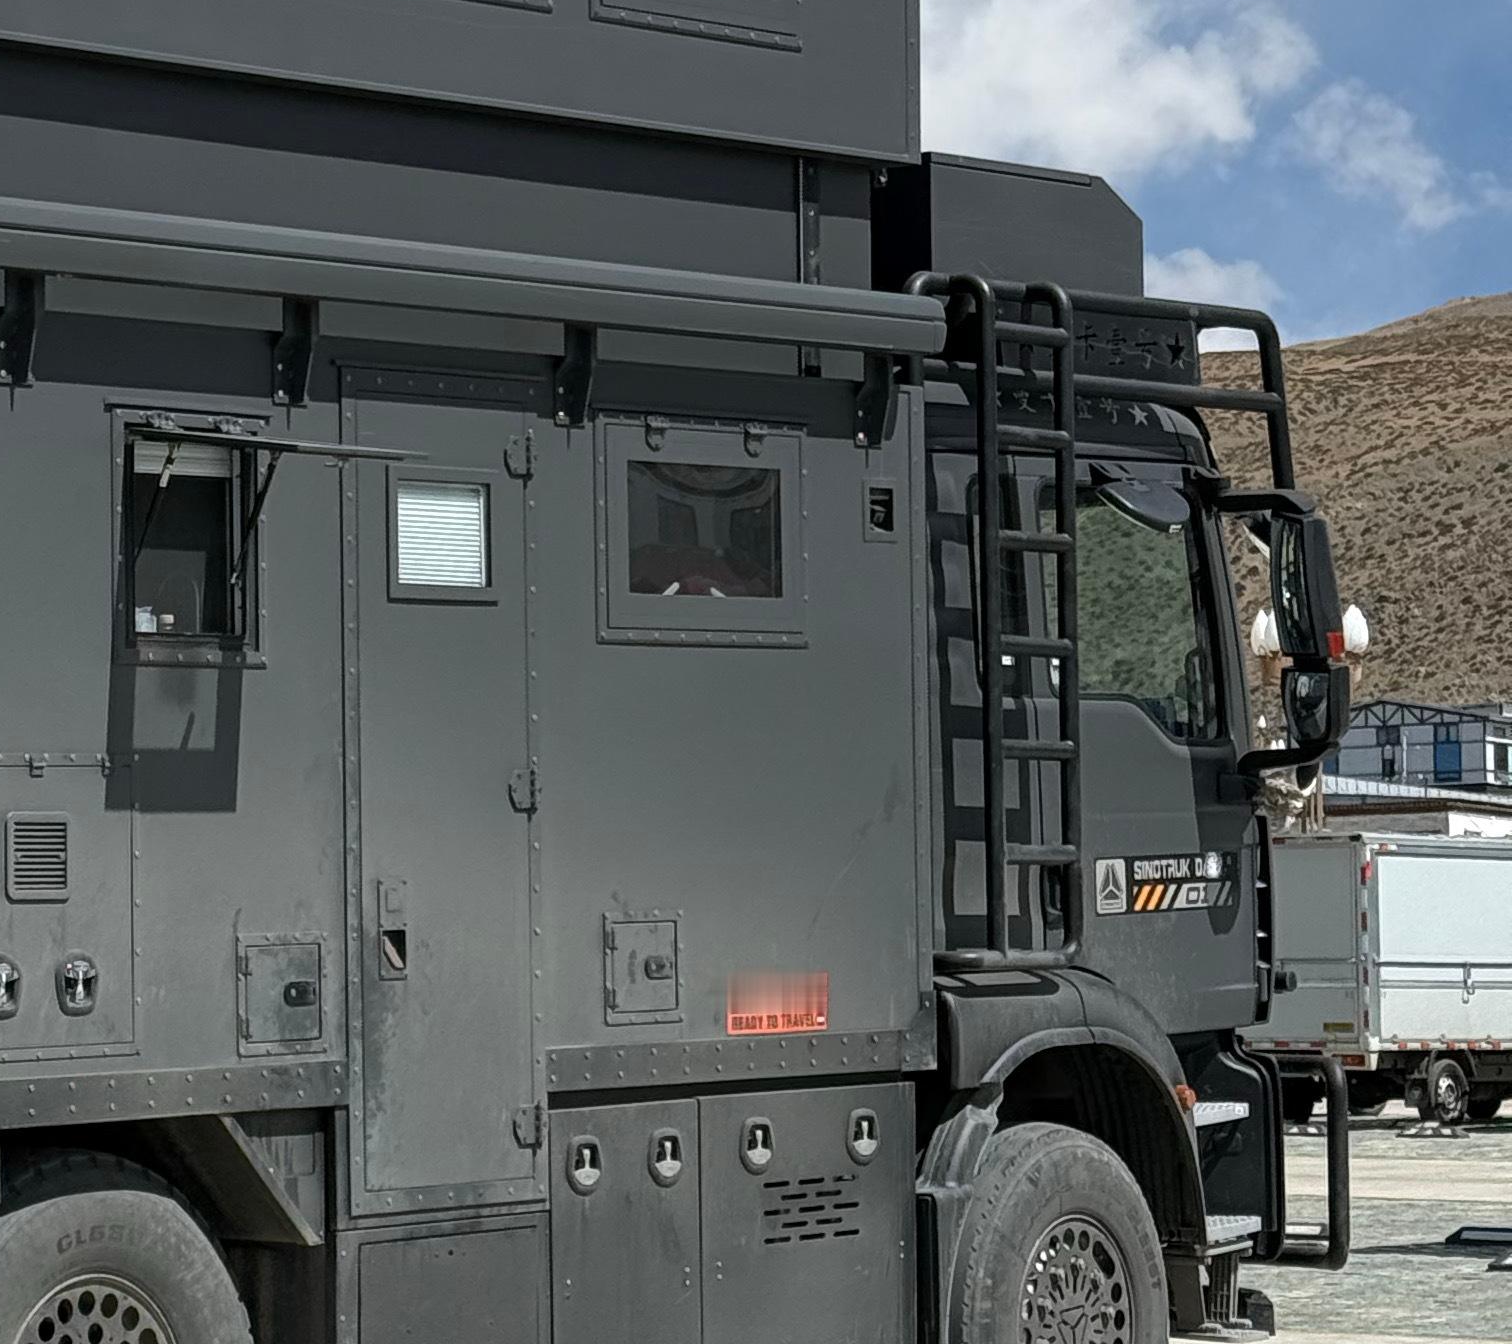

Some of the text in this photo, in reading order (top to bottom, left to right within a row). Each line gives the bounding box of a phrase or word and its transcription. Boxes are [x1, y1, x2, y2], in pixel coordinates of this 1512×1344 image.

[1133, 858, 1191, 880] SINOTRUK
[731, 1013, 815, 1031] READY TO TRAVEL
